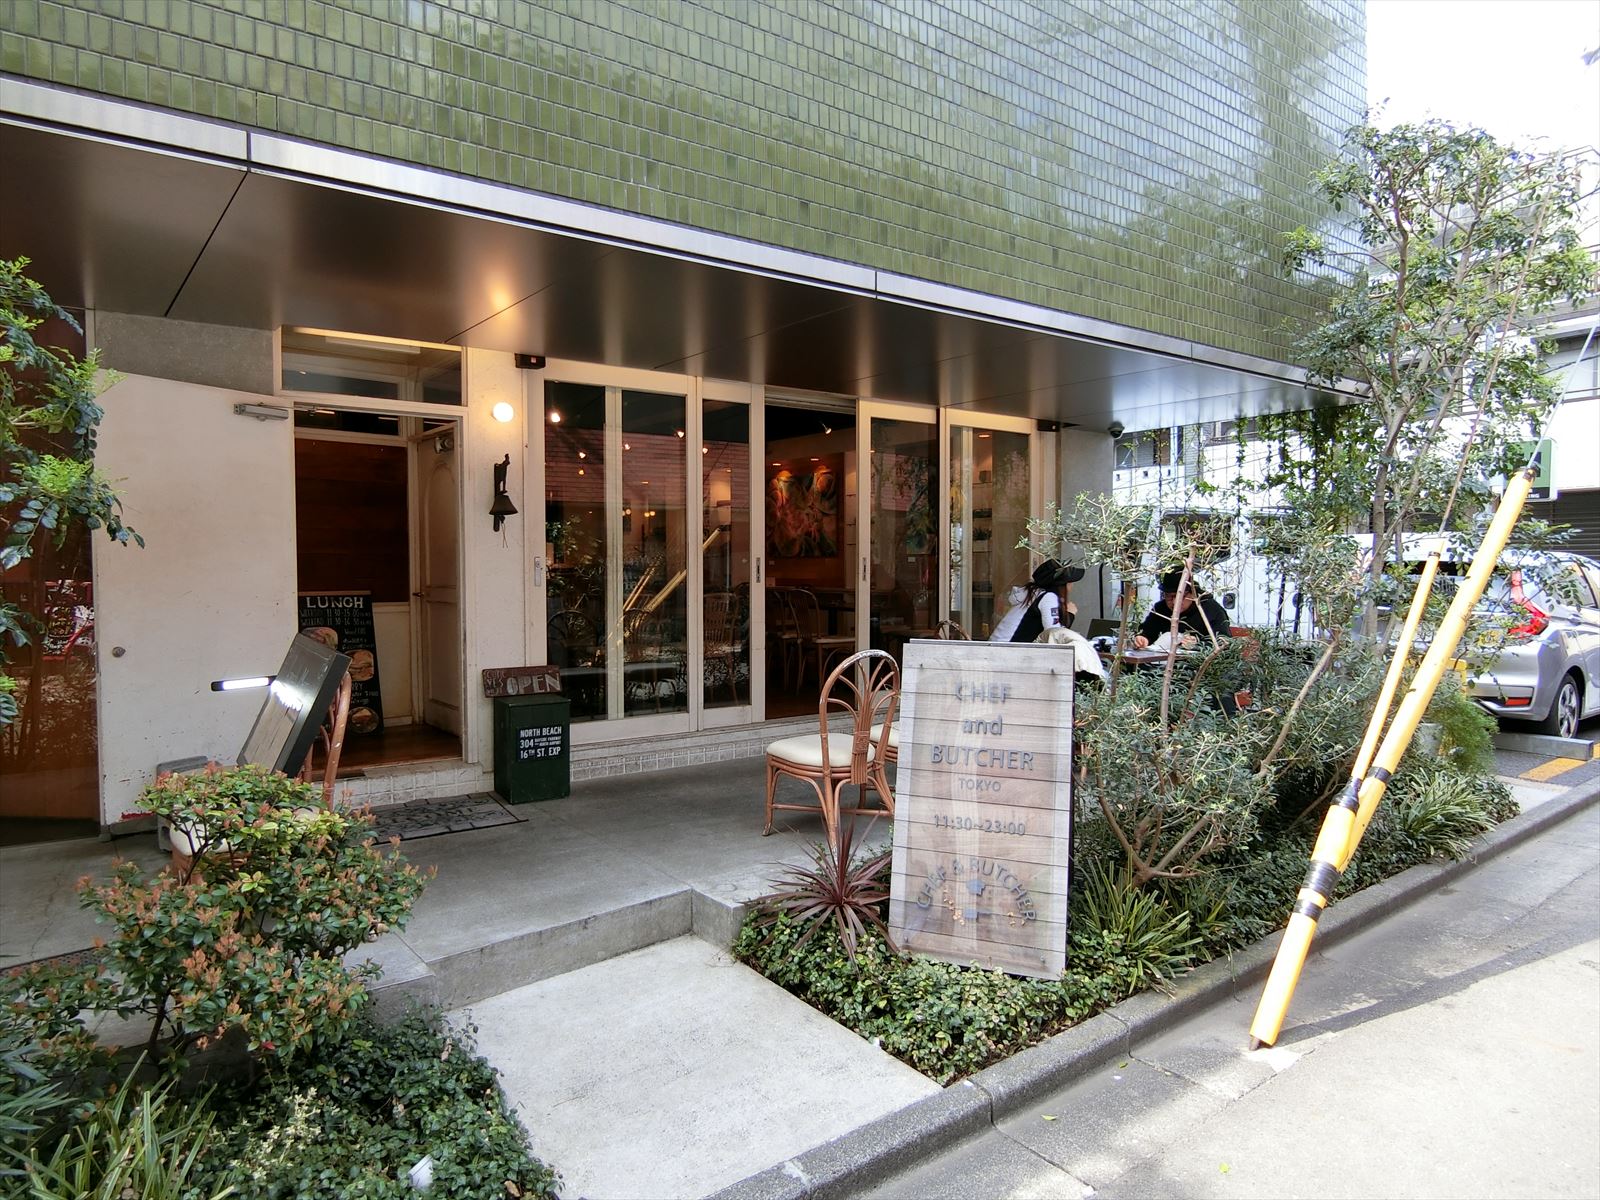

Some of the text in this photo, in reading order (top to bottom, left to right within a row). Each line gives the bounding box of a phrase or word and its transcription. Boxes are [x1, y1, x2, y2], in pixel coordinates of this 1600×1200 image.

[305, 596, 364, 609] LUNCH
[506, 672, 561, 695] OPEN
[955, 681, 1012, 704] CHEF
[520, 726, 562, 738] NORTH BEACH
[963, 713, 1003, 736] and
[519, 739, 534, 749] 304
[536, 747, 547, 758] ST.
[548, 746, 561, 756] EXP
[930, 744, 1034, 771] BUTCHER
[958, 777, 1002, 792] TOKYO
[916, 857, 1037, 921] CHEF & BUTCHER
